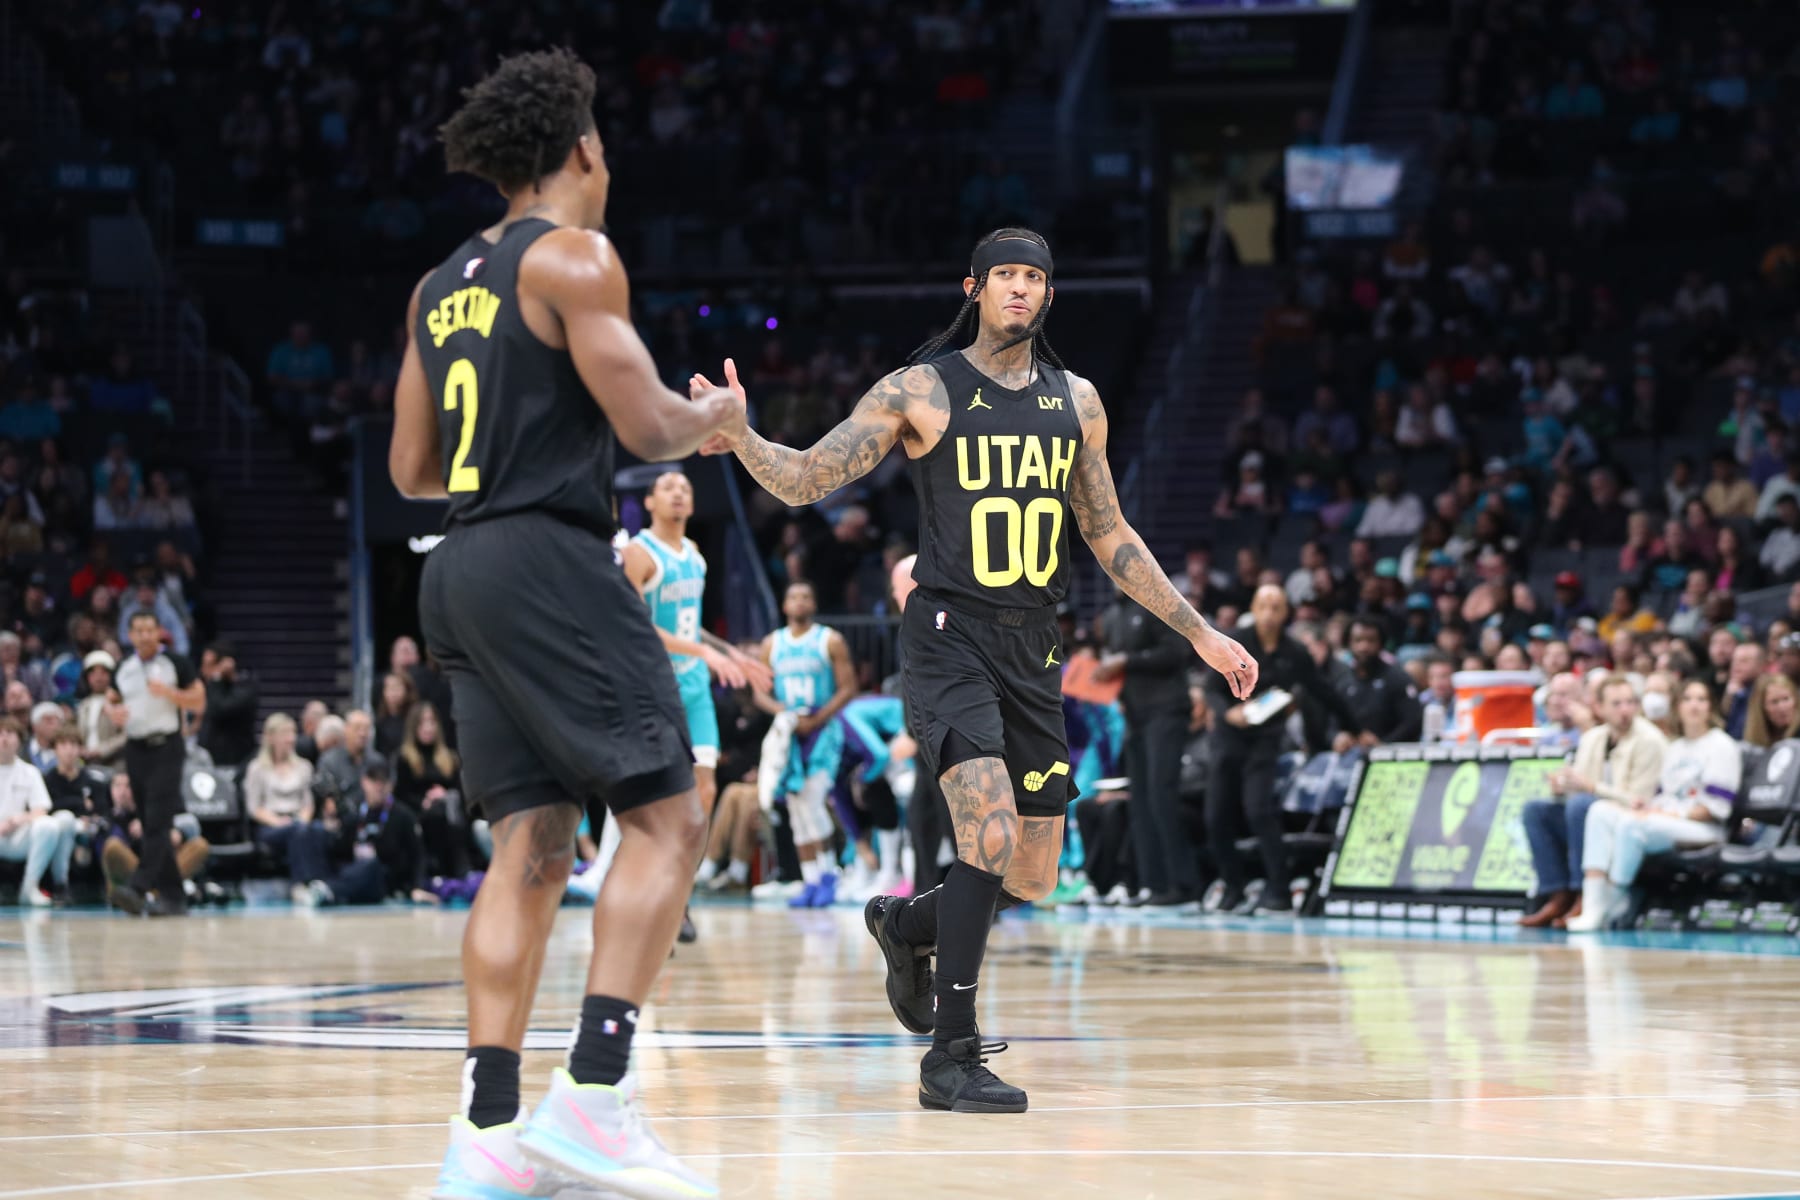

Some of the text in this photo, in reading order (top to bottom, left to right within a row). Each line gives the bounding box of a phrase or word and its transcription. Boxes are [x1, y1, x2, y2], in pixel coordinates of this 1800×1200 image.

[443, 358, 480, 493] 2
[956, 435, 1077, 492] UTAH
[971, 497, 1063, 587] 00
